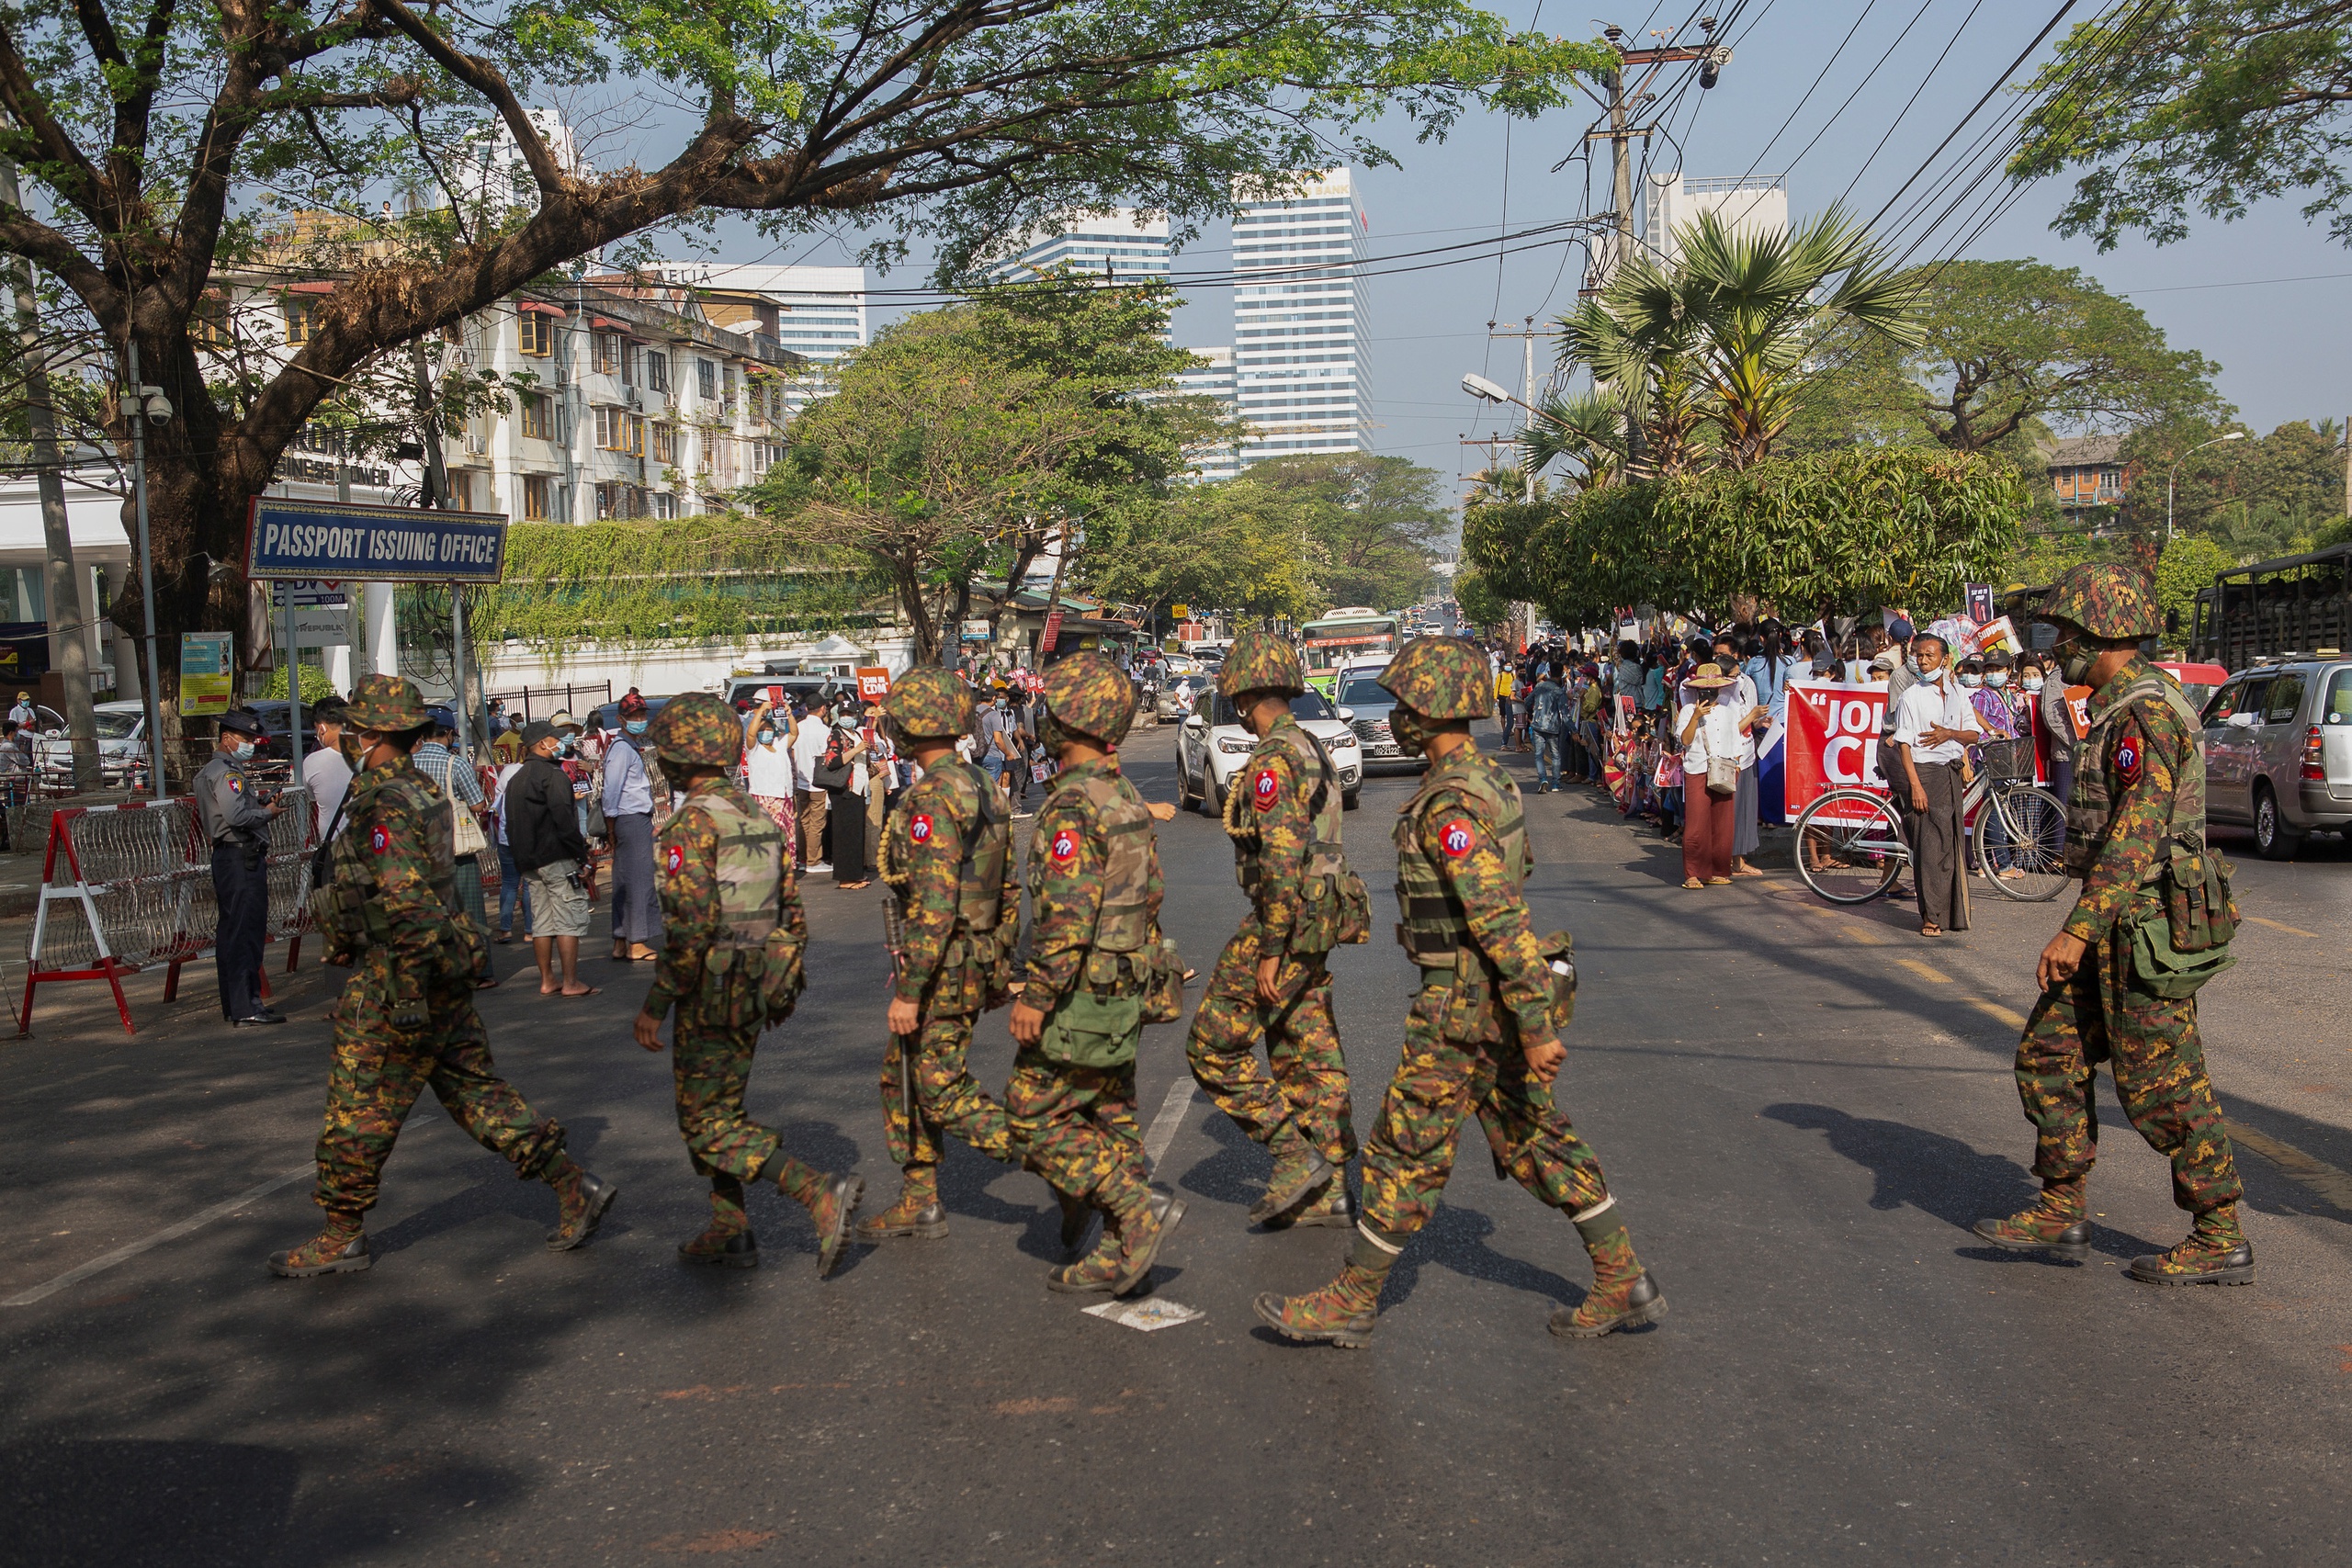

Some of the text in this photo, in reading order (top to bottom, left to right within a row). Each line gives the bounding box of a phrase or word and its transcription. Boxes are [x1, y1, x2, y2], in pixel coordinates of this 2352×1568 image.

[264, 523, 496, 564] PASSPORT ISSUING OFFICE
[321, 594, 343, 604] 100M
[1810, 693, 1884, 739] “JOI
